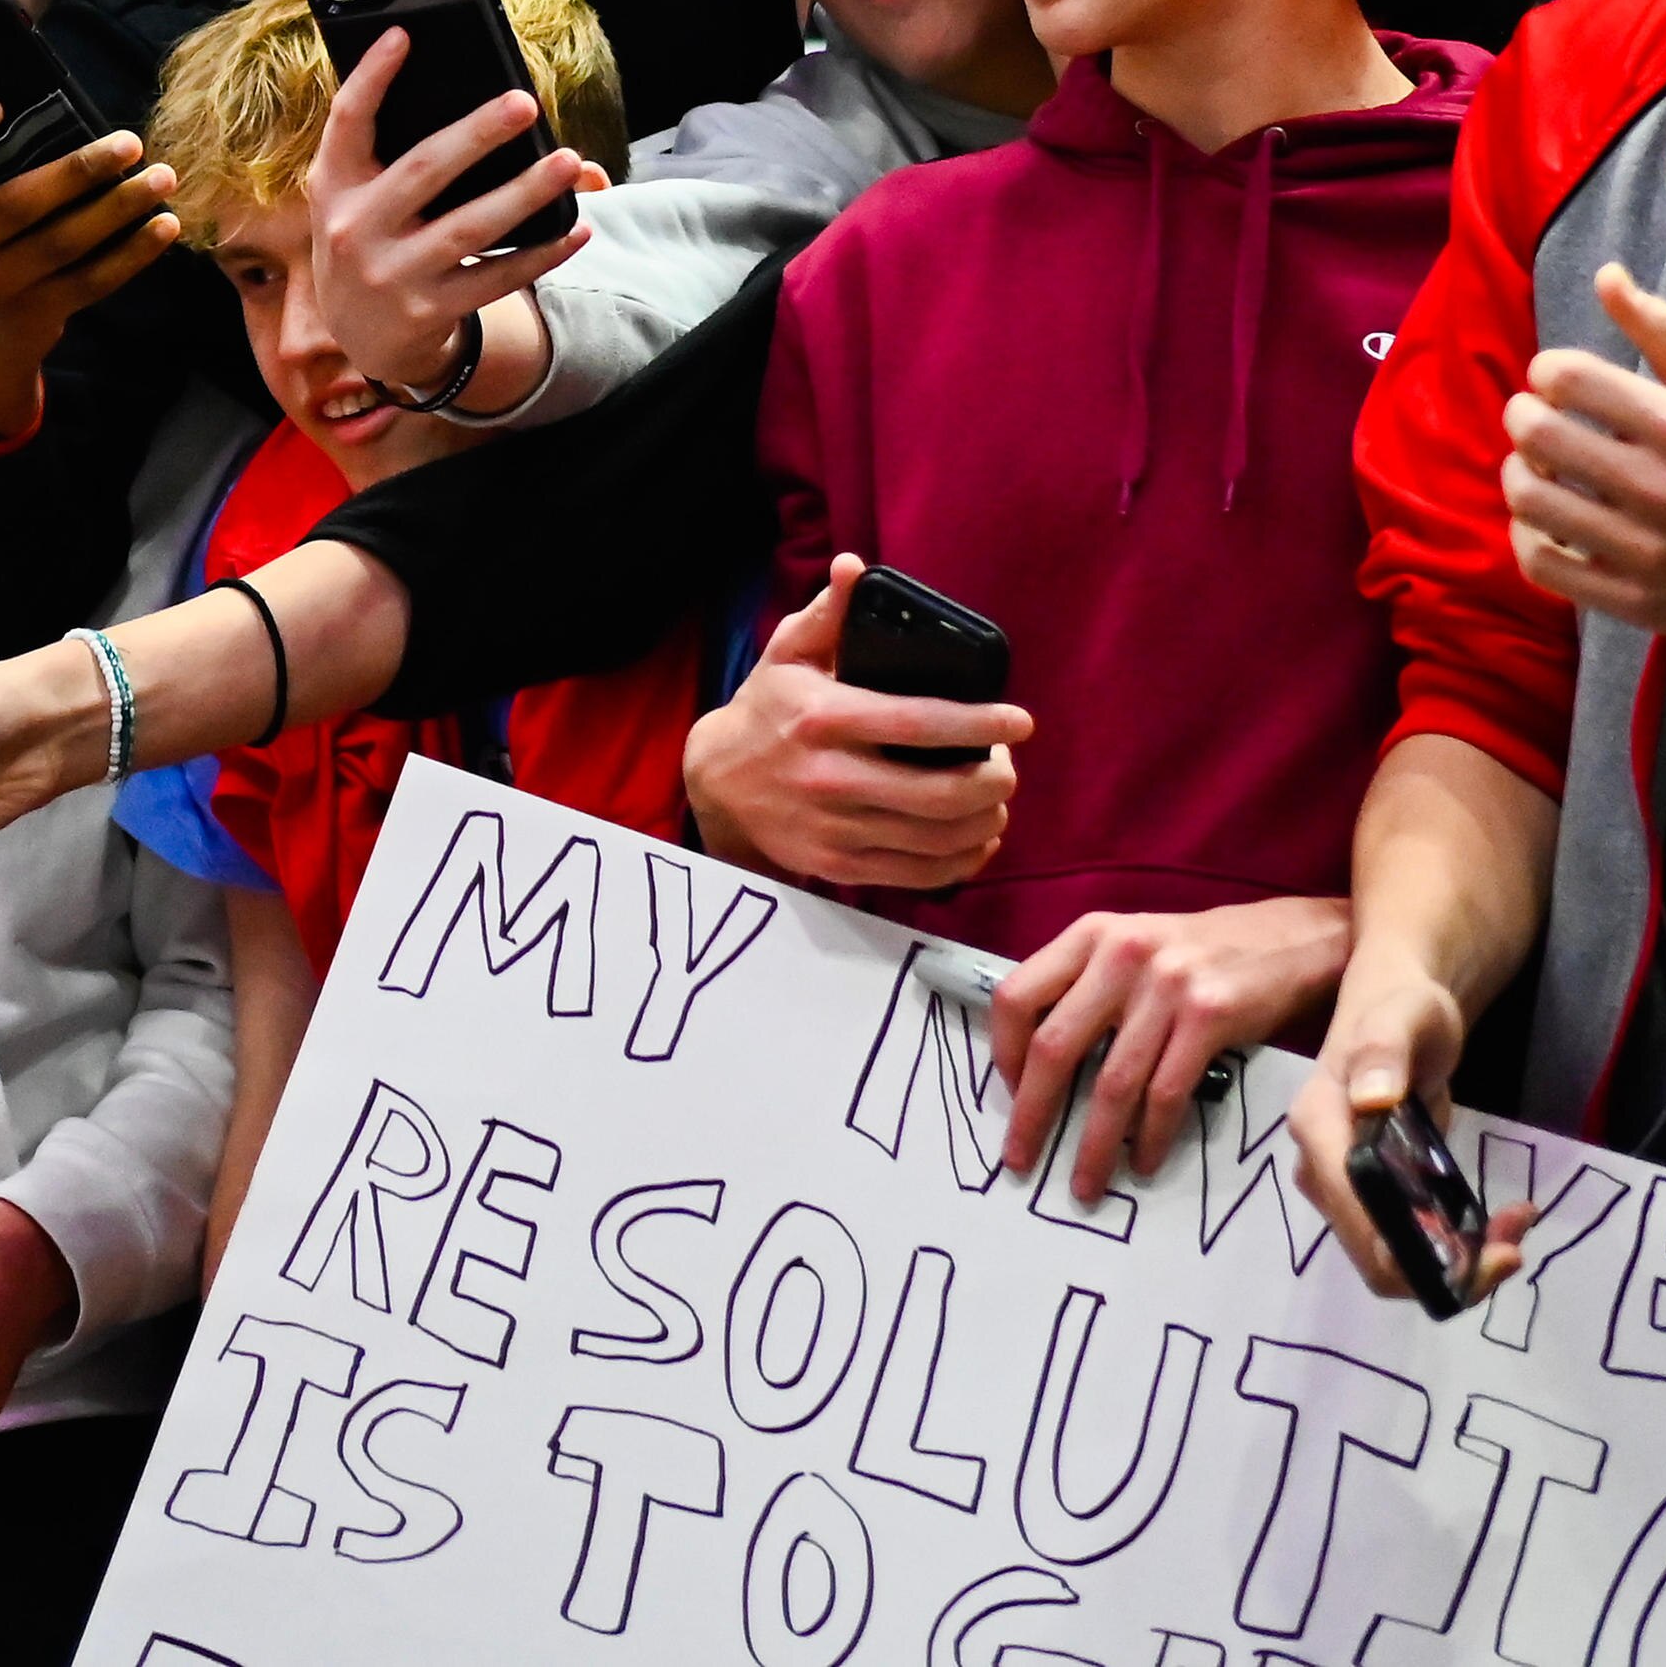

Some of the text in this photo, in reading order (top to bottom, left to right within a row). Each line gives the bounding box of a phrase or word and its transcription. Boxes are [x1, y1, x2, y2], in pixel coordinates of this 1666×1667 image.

[377, 808, 779, 1062] MY
[164, 1314, 874, 1667] IS TO
